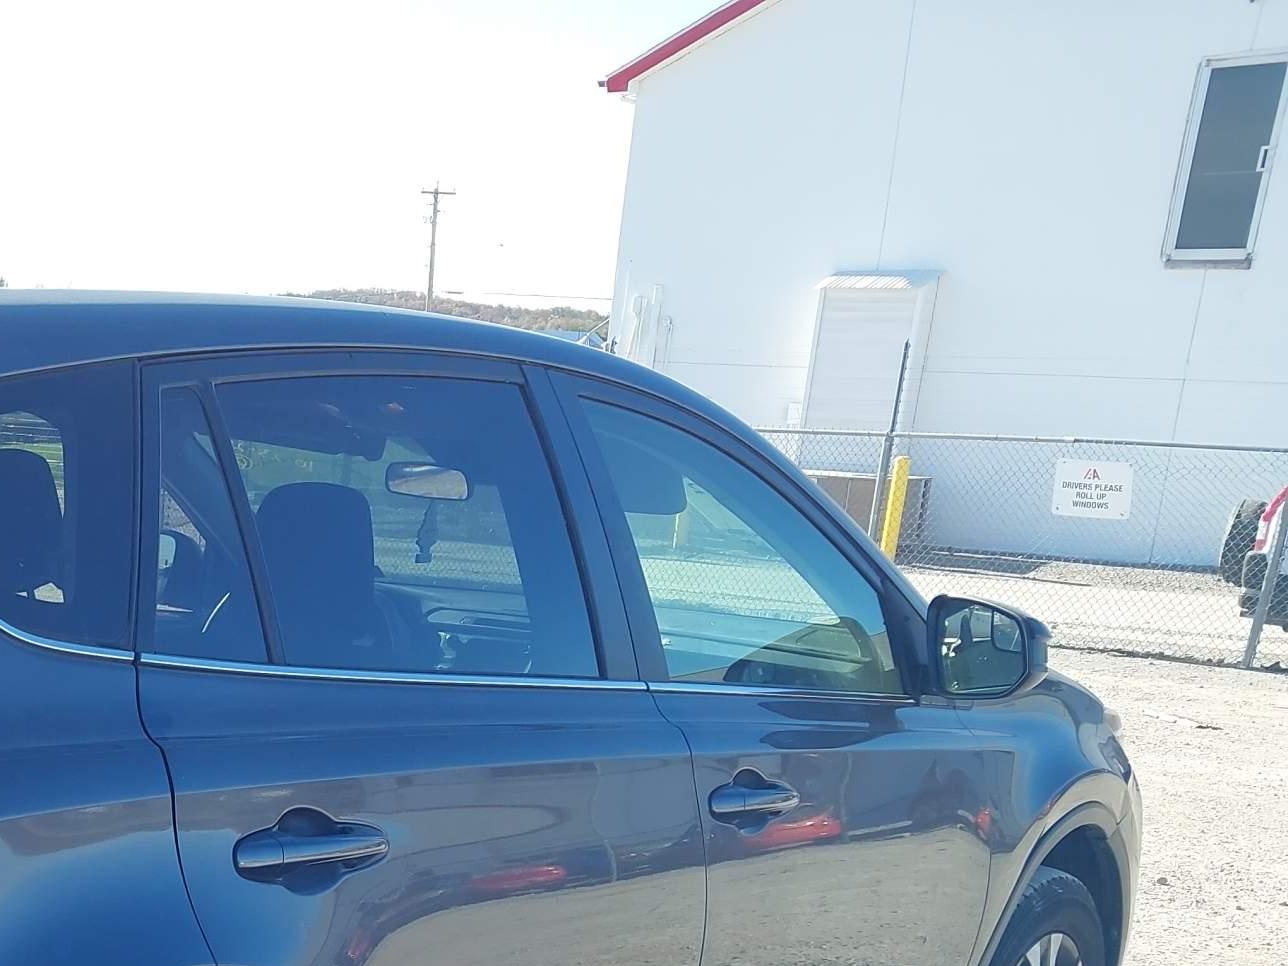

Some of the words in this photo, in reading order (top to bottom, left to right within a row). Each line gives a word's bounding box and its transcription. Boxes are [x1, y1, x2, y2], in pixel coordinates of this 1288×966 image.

[1062, 481, 1092, 491] DRIVERS
[1094, 483, 1123, 492] PLEASE
[1075, 491, 1094, 500] ROLL
[1072, 500, 1109, 510] WINDOWS
